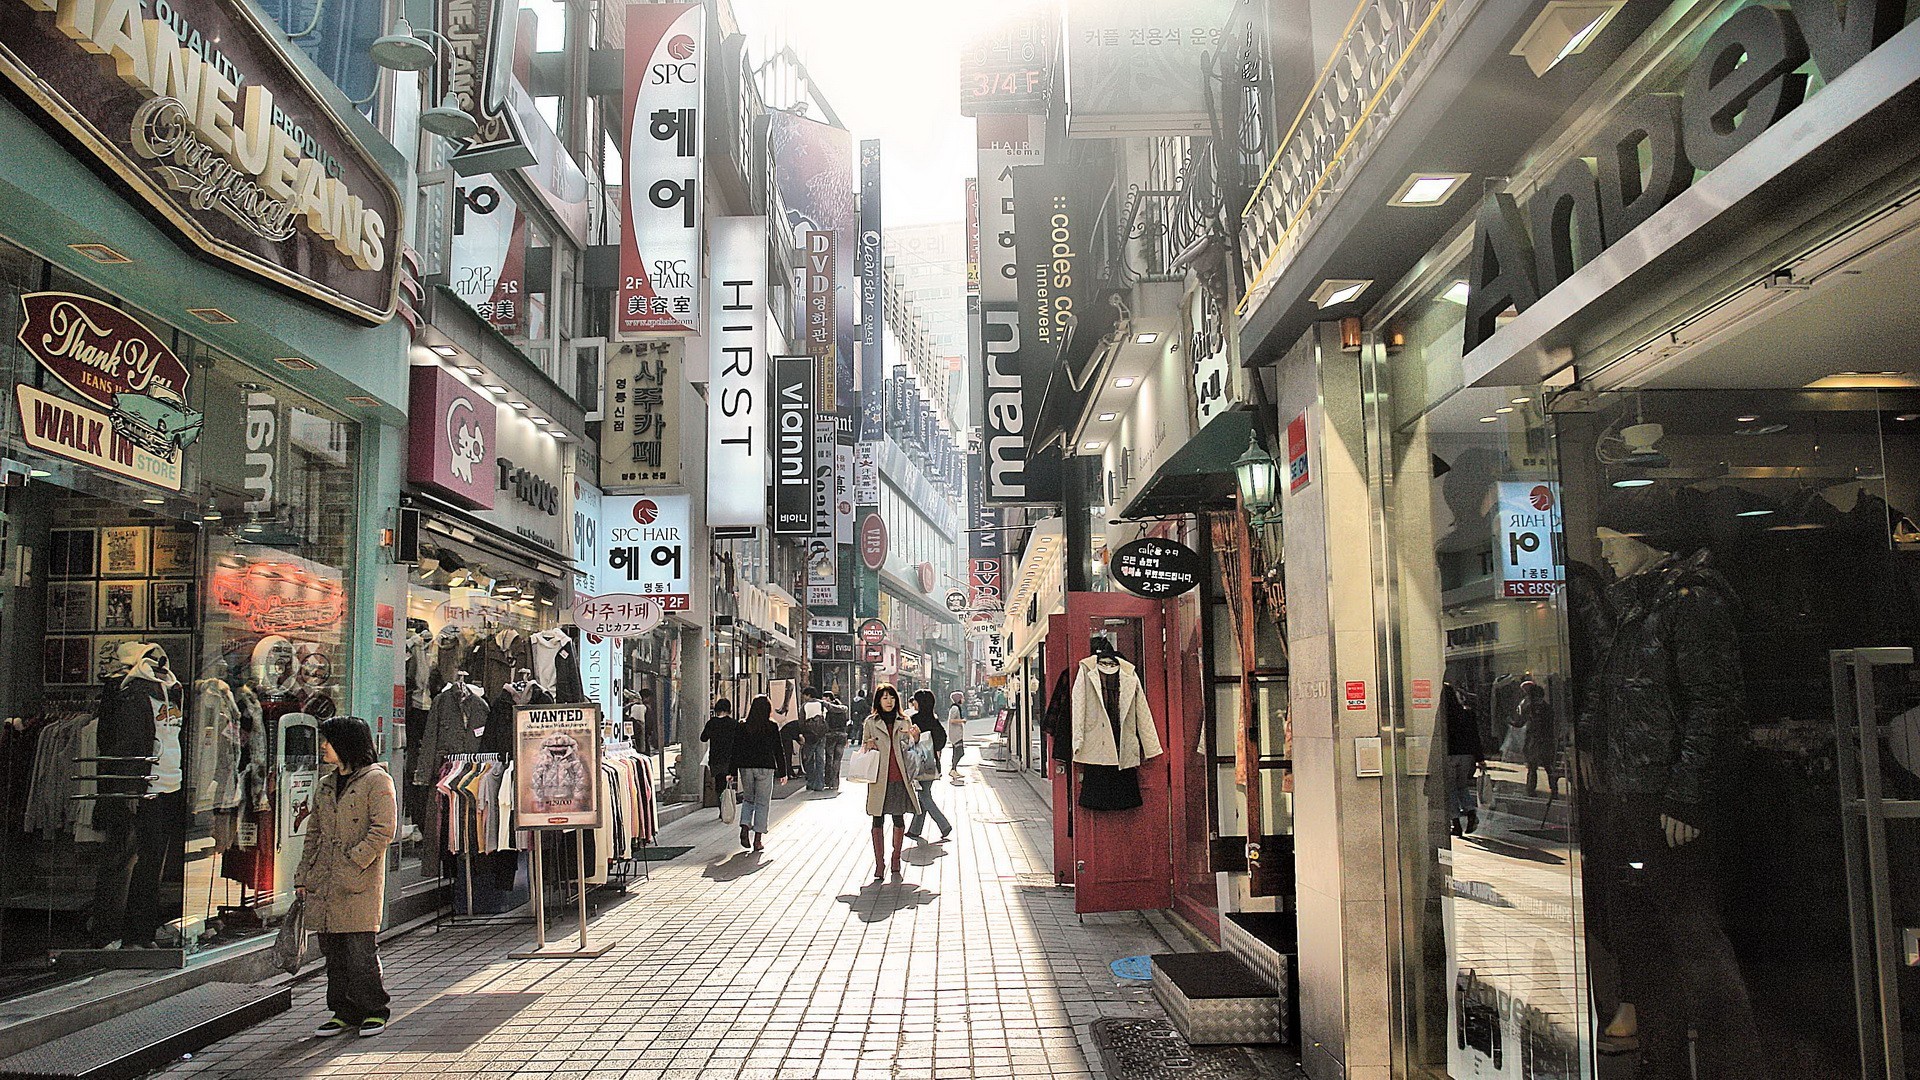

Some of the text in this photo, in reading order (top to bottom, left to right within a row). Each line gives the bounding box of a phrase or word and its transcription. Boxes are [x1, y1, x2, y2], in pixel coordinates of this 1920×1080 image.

[1084, 28, 1119, 47] 커플
[1129, 28, 1181, 46] 전용석
[652, 63, 697, 85] SPC
[272, 107, 346, 178] PRODUCT
[991, 141, 1029, 151] HAIR
[649, 109, 697, 228] 헤어
[1050, 213, 1076, 289] codes
[653, 260, 687, 276] SPC
[625, 273, 694, 290] 2F HAIR
[628, 296, 691, 315] 美容室
[1036, 263, 1050, 344] innerwear
[42, 301, 120, 377] Thank
[720, 279, 753, 457] HIRST
[80, 371, 113, 394] JEANS
[632, 360, 668, 468] 사주카페
[987, 311, 1026, 498] maru
[34, 399, 134, 467] WALK IN
[781, 382, 810, 485] vianni
[817, 432, 833, 443] afé
[137, 455, 177, 481] STORE
[611, 527, 681, 541] SPC HAIR
[866, 528, 881, 553] VIPS
[608, 545, 682, 581] 헤어
[1142, 582, 1171, 593] 2,3F
[581, 602, 649, 621] 사주카페
[669, 597, 684, 608] 2F
[588, 650, 600, 673] SPC
[529, 709, 583, 723] WANTED
